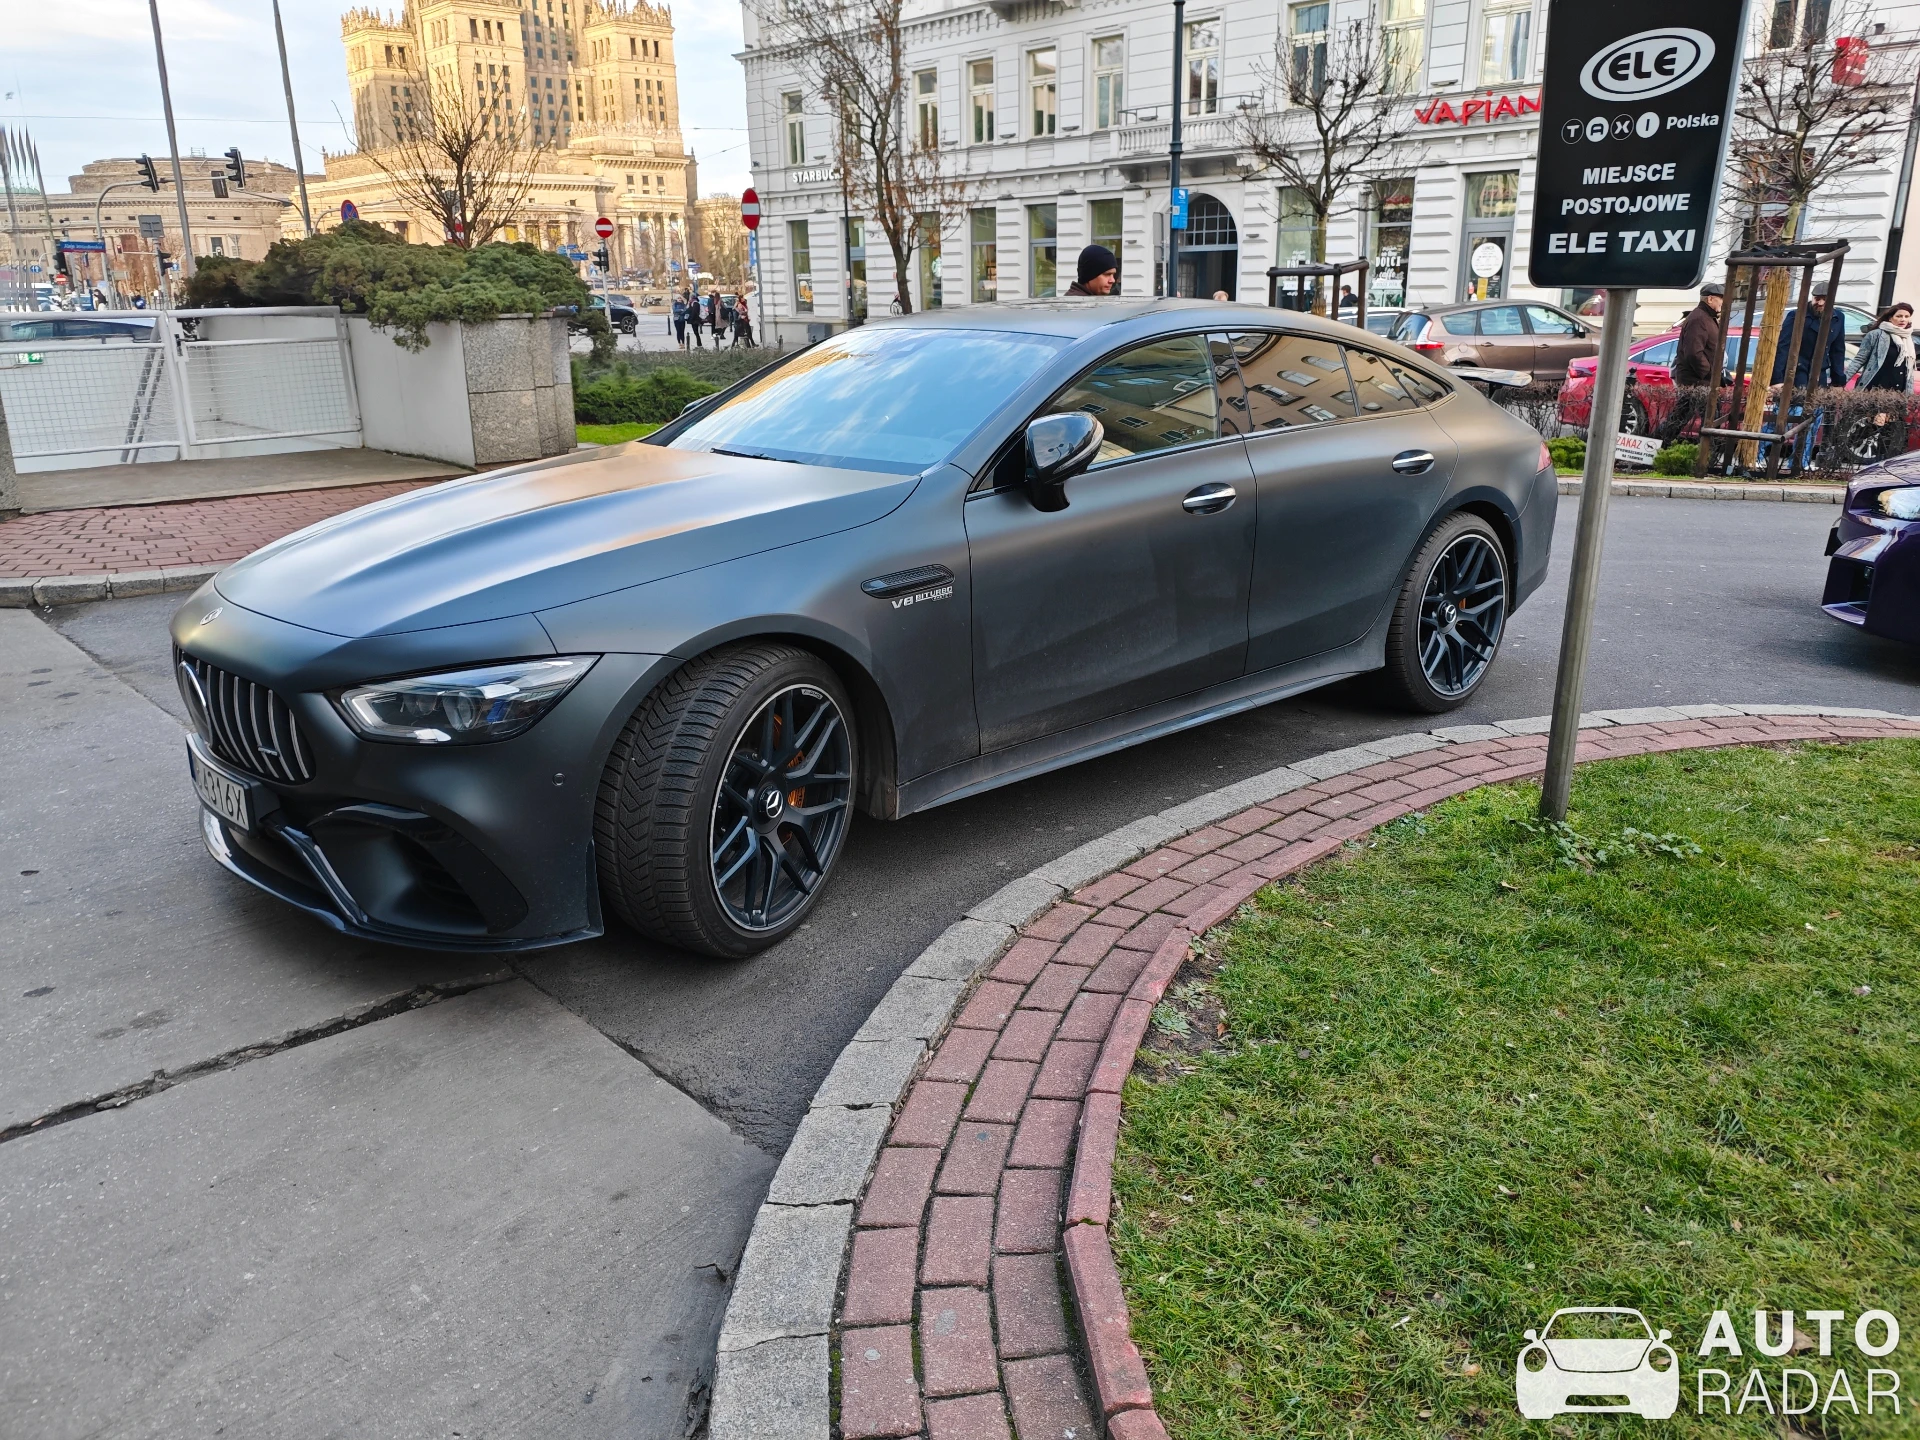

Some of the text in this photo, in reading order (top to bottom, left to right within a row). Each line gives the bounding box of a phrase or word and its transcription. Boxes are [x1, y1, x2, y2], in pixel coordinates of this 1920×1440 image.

[1608, 46, 1678, 82] ELE
[1563, 113, 1720, 142] TAXI Polska
[1582, 162, 1677, 185] MIEJSCE
[1561, 193, 1691, 216] POSTOJOWE
[1548, 229, 1697, 254] ELE TAXI
[1616, 436, 1642, 449] ZAKAZ
[891, 596, 914, 609] V8
[915, 586, 953, 602] BITURBO
